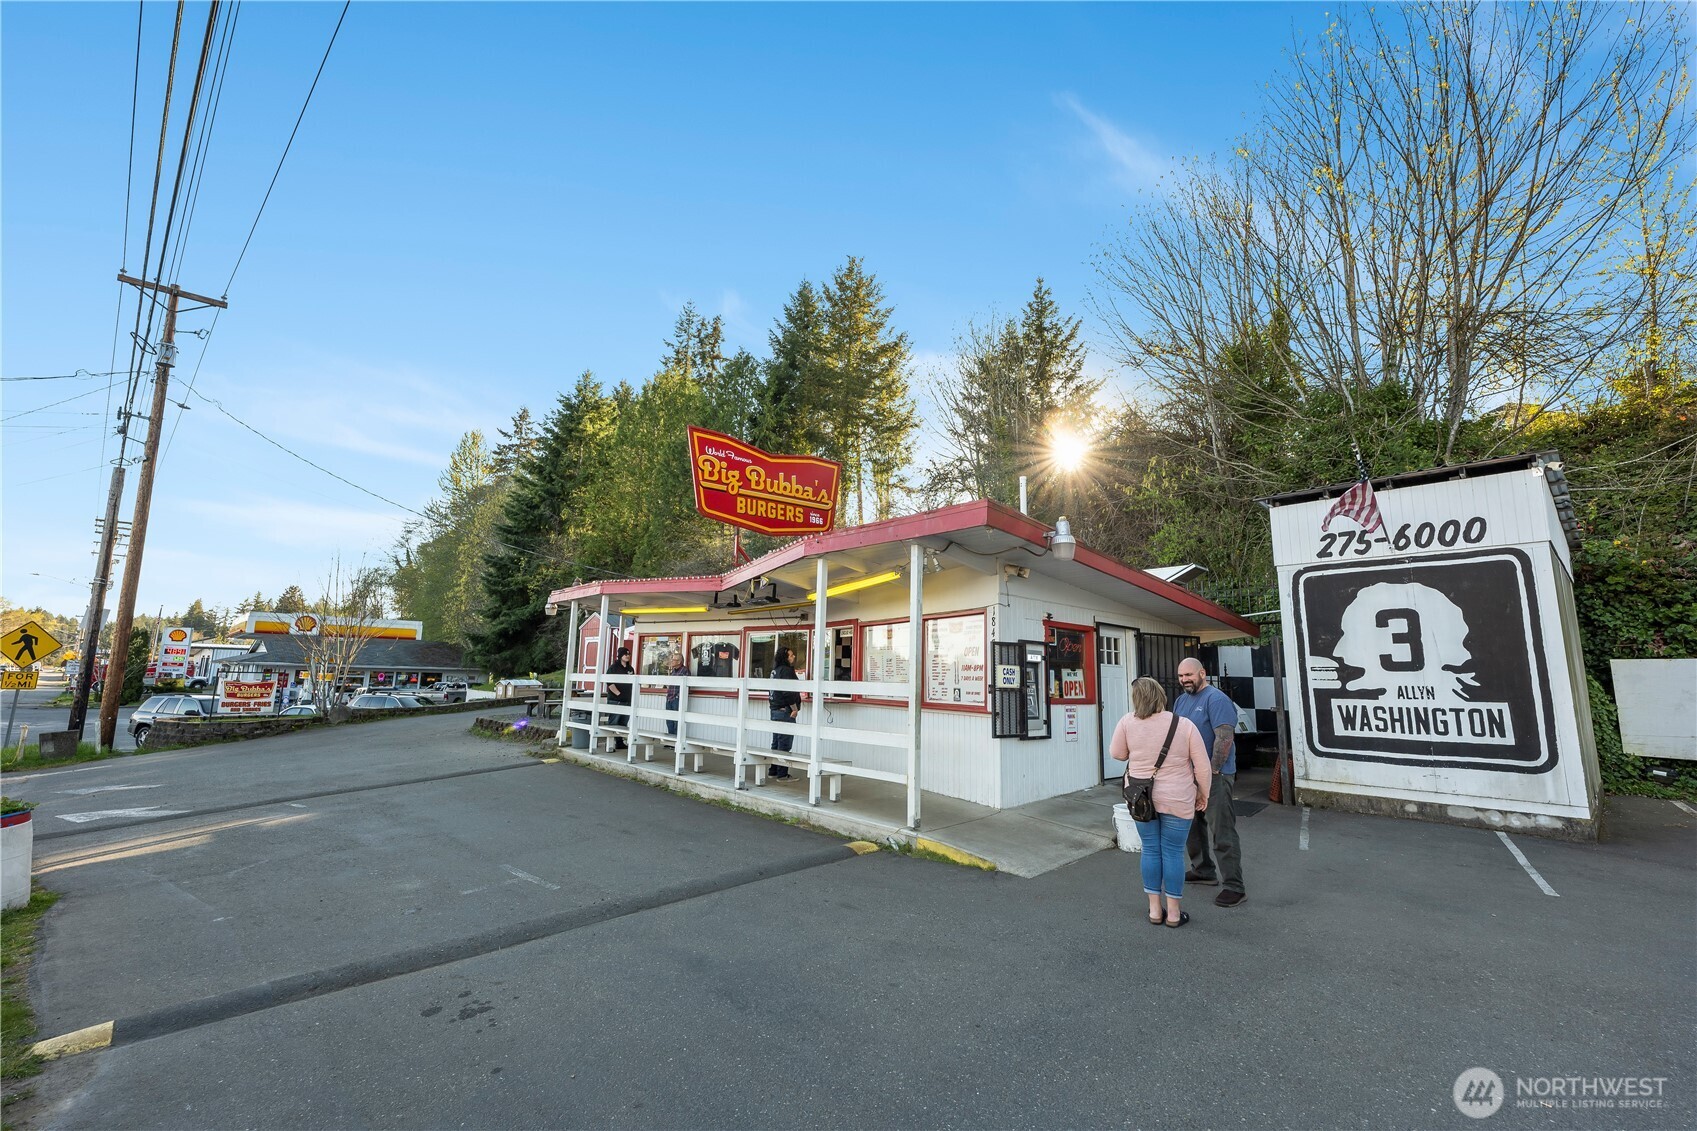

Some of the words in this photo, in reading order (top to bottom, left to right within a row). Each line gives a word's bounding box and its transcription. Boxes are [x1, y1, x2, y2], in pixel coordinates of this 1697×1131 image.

[705, 445, 726, 457] World
[726, 450, 752, 463] Famous
[698, 454, 743, 495] Big
[745, 465, 830, 506] Bubba's
[736, 496, 804, 523] BURGERS
[809, 516, 824, 525] 1966
[1316, 516, 1488, 559] 275-6000
[1059, 637, 1082, 656] Open
[1375, 607, 1425, 673] 3
[964, 646, 980, 656] OPEN
[1002, 667, 1016, 676] CASH
[1002, 676, 1016, 685] ONLY
[1063, 680, 1084, 697] OPEN
[1397, 685, 1435, 701] ALLYN
[1337, 704, 1507, 739] WASHINGTON
